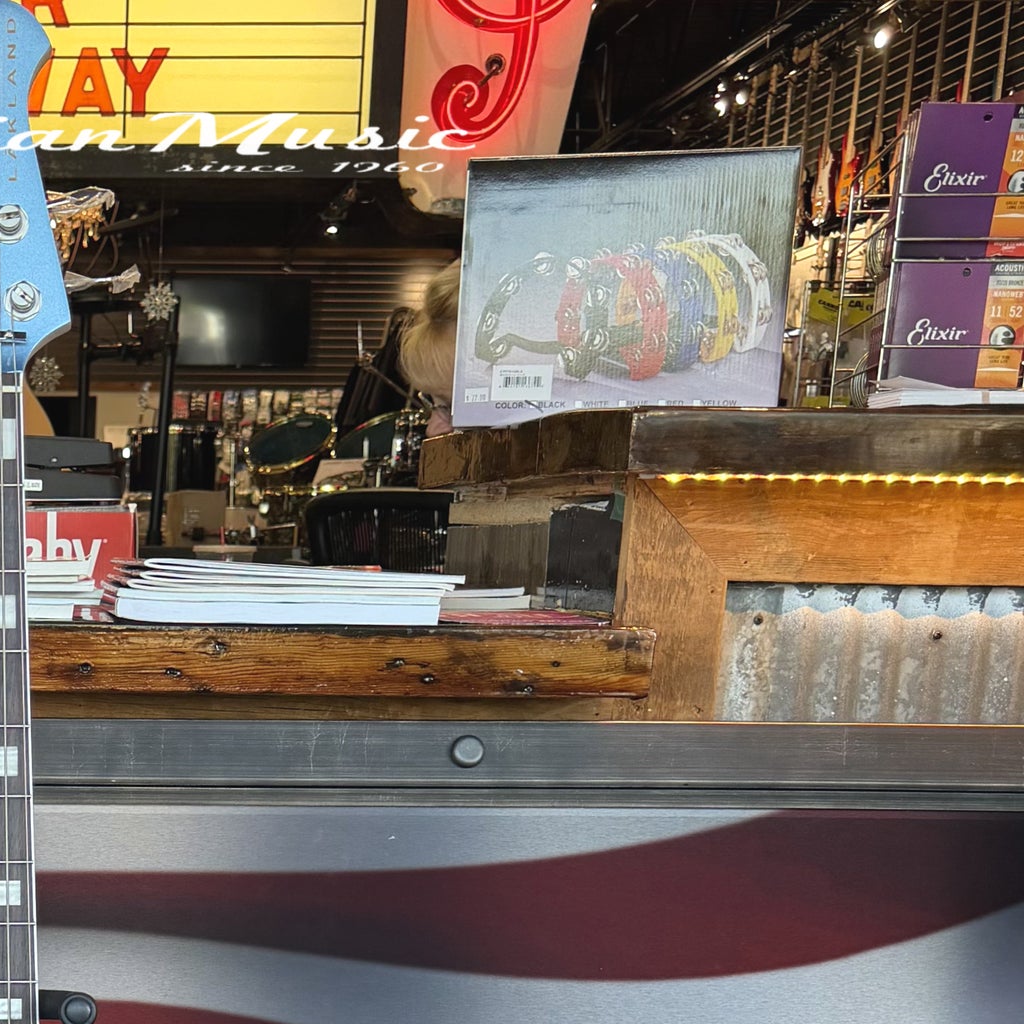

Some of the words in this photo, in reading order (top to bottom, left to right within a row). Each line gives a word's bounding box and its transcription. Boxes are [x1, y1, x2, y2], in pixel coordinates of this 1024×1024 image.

[923, 163, 986, 192] Elixir
[1009, 306, 1023, 317] 52
[906, 318, 967, 346] Elixir
[495, 401, 527, 410] COLOR:
[537, 400, 566, 408] BLACK
[582, 400, 609, 408] WHITE
